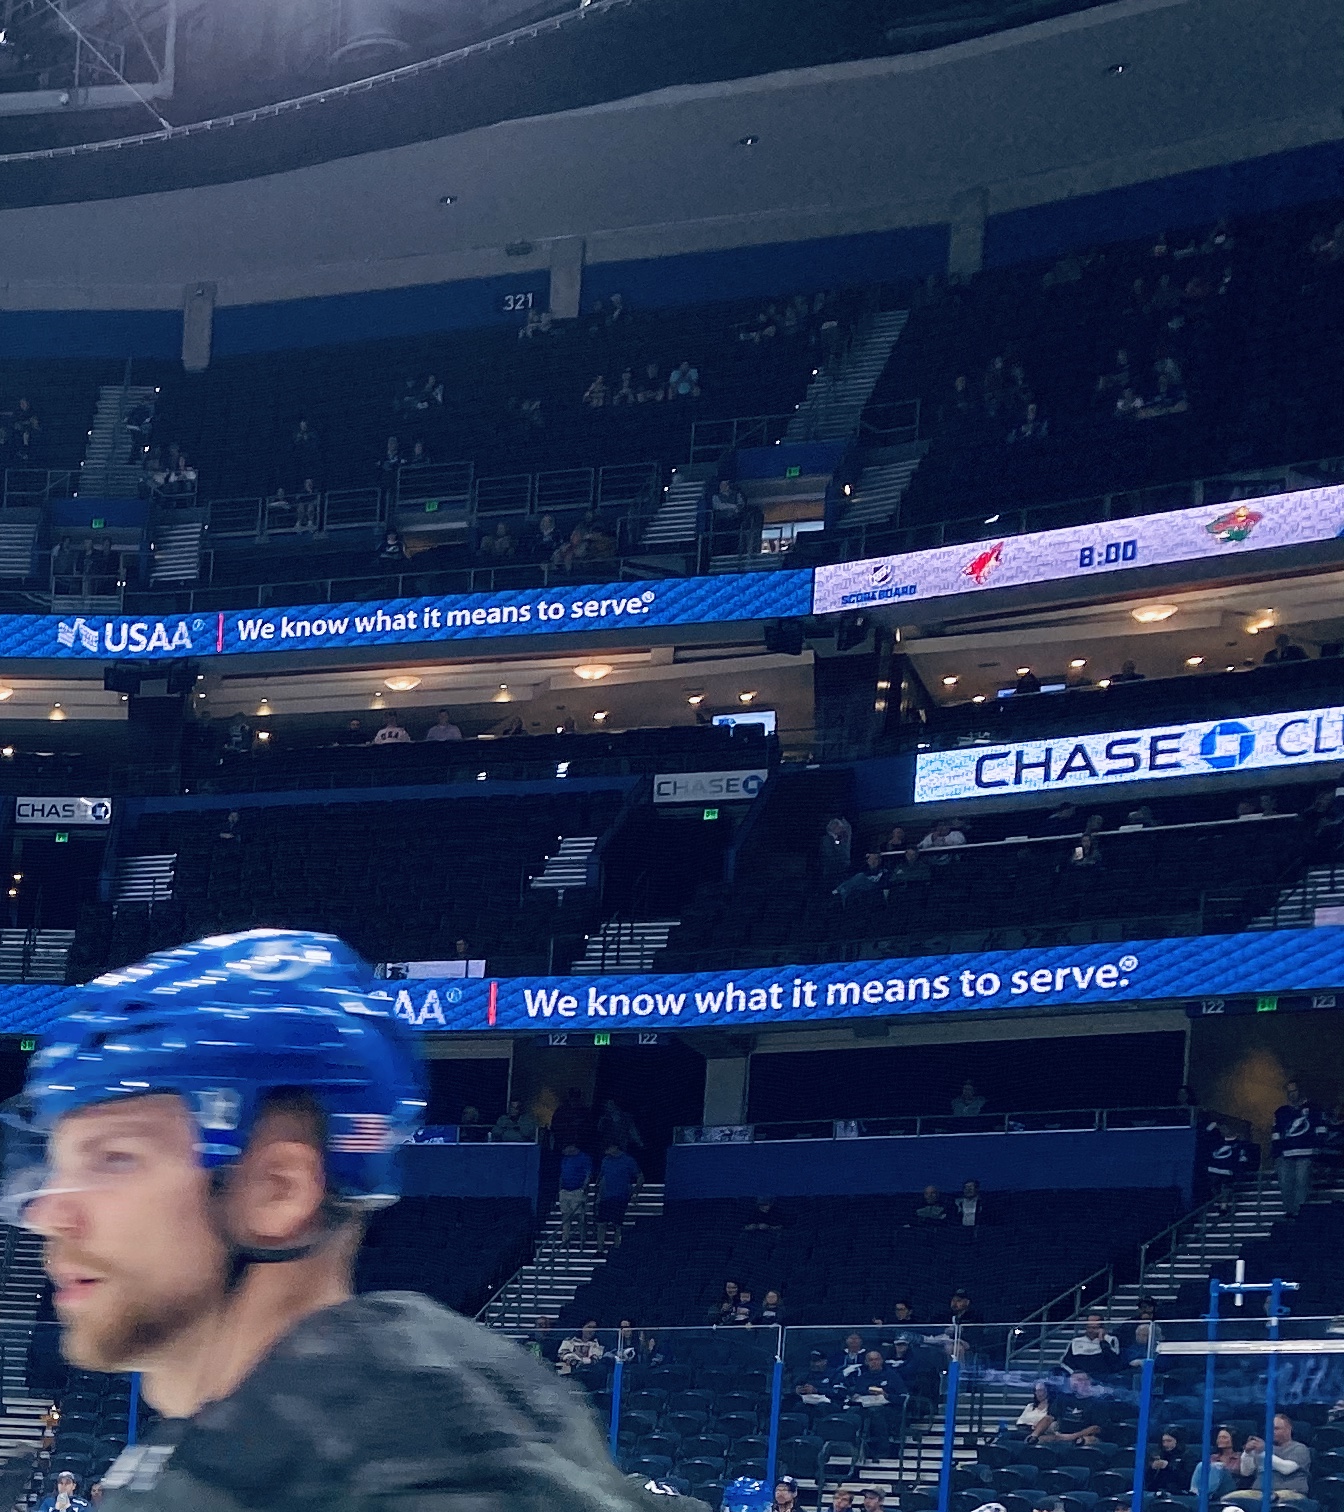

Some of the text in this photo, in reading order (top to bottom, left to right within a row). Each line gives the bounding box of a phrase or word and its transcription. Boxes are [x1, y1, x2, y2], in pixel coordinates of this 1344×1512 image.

[503, 293, 533, 311] 321
[1079, 540, 1137, 569] 8:00
[237, 618, 275, 641] We
[280, 616, 350, 639] know
[354, 609, 418, 633] what
[423, 606, 442, 629] it
[446, 604, 531, 627] means
[536, 600, 566, 621] to
[974, 714, 1344, 789] CHASE CL
[656, 777, 740, 796] CHASE
[523, 988, 578, 1018] We
[587, 986, 687, 1017] know
[694, 981, 784, 1014] what
[792, 978, 818, 1008] it
[826, 975, 950, 1006] means
[959, 969, 1001, 998] to
[1202, 1002, 1224, 1014] 122
[548, 1034, 568, 1046] 122
[637, 1033, 658, 1046] 122
